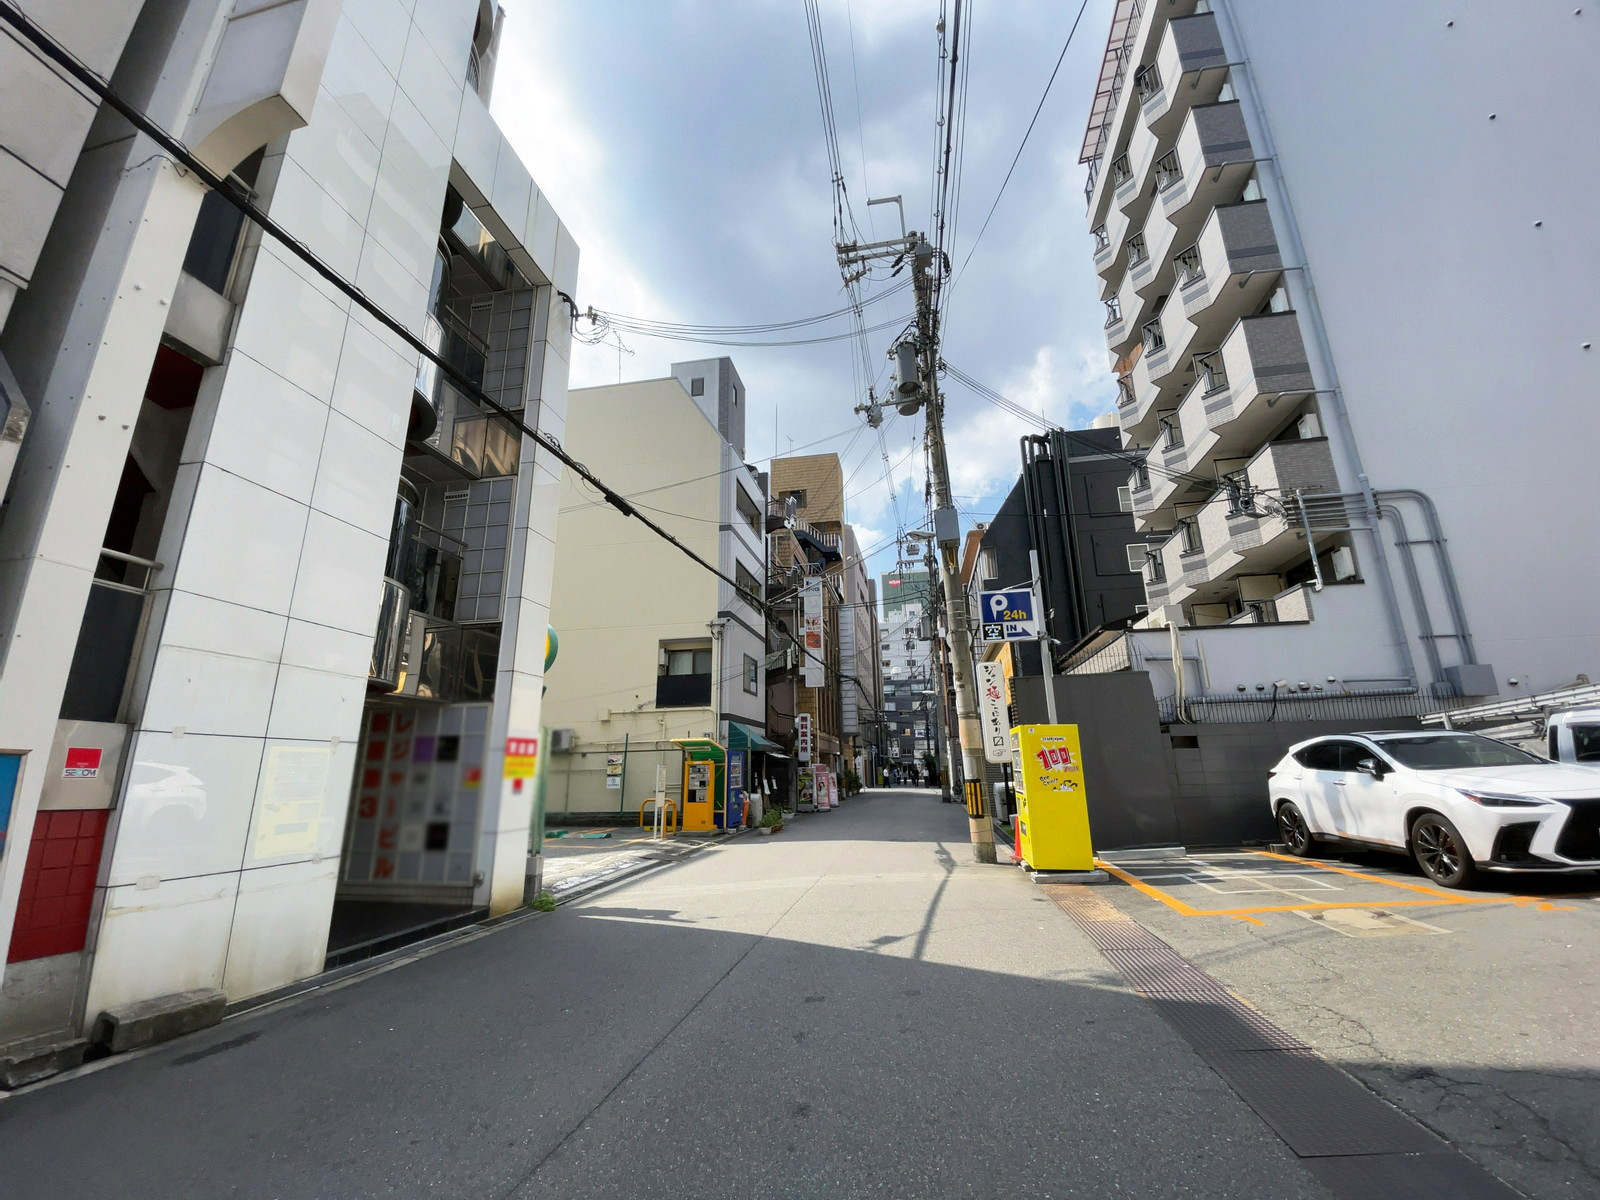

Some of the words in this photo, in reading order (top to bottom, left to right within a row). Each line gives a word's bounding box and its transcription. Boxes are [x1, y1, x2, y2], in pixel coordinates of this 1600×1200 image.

[990, 594, 1008, 621] P
[1003, 610, 1027, 620] 24h
[985, 624, 1002, 640] 空
[800, 716, 808, 753] 無料案内所
[1036, 747, 1071, 770] 100
[64, 768, 97, 777] SECOM
